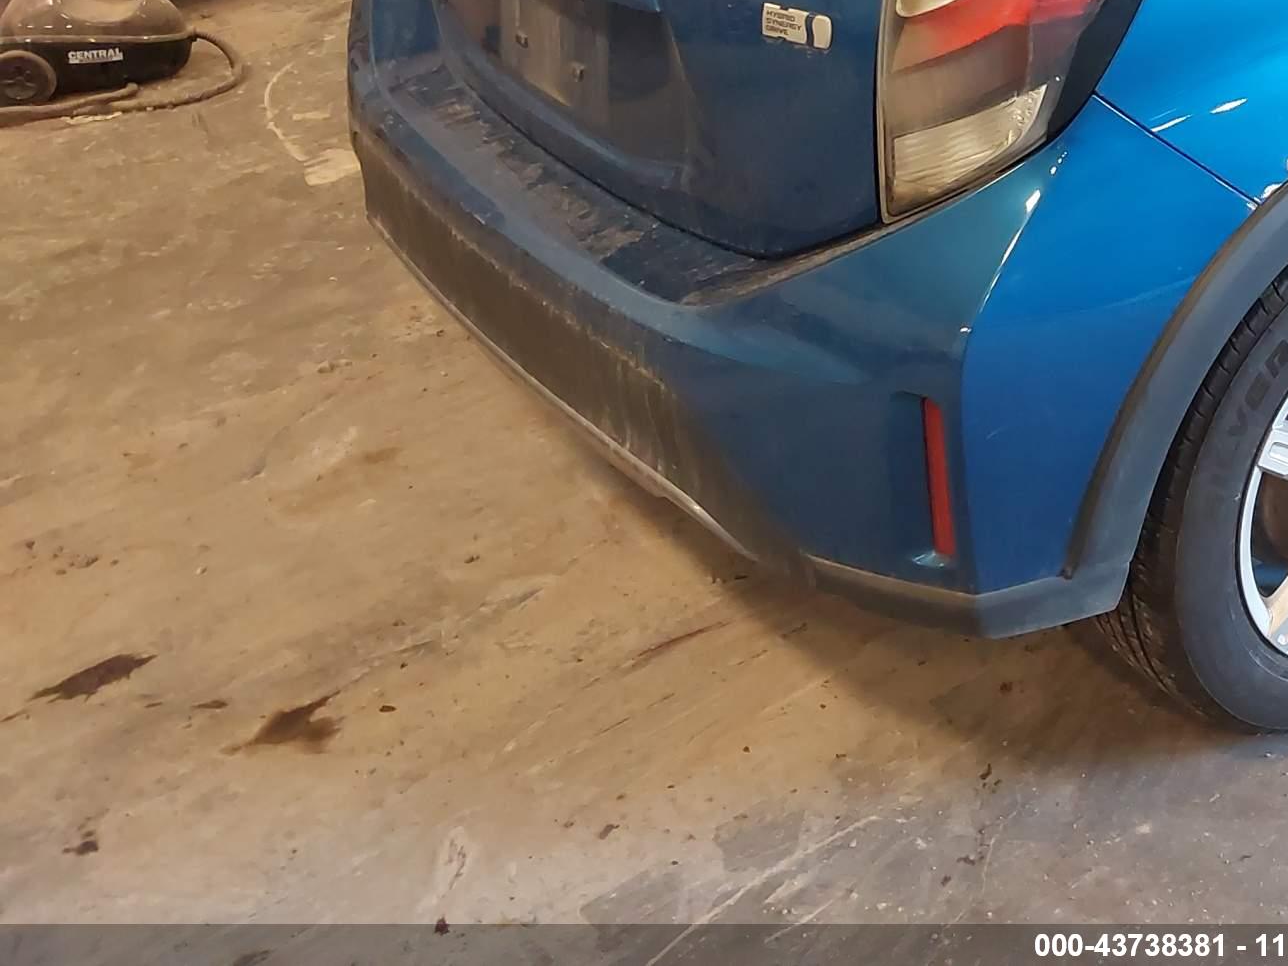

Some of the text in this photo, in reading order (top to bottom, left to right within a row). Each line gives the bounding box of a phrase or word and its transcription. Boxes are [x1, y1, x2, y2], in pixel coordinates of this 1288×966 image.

[766, 10, 796, 22] HYBRID
[765, 24, 789, 36] DRIVE
[766, 17, 802, 31] SYNERGY
[67, 47, 122, 60] CENTRAL
